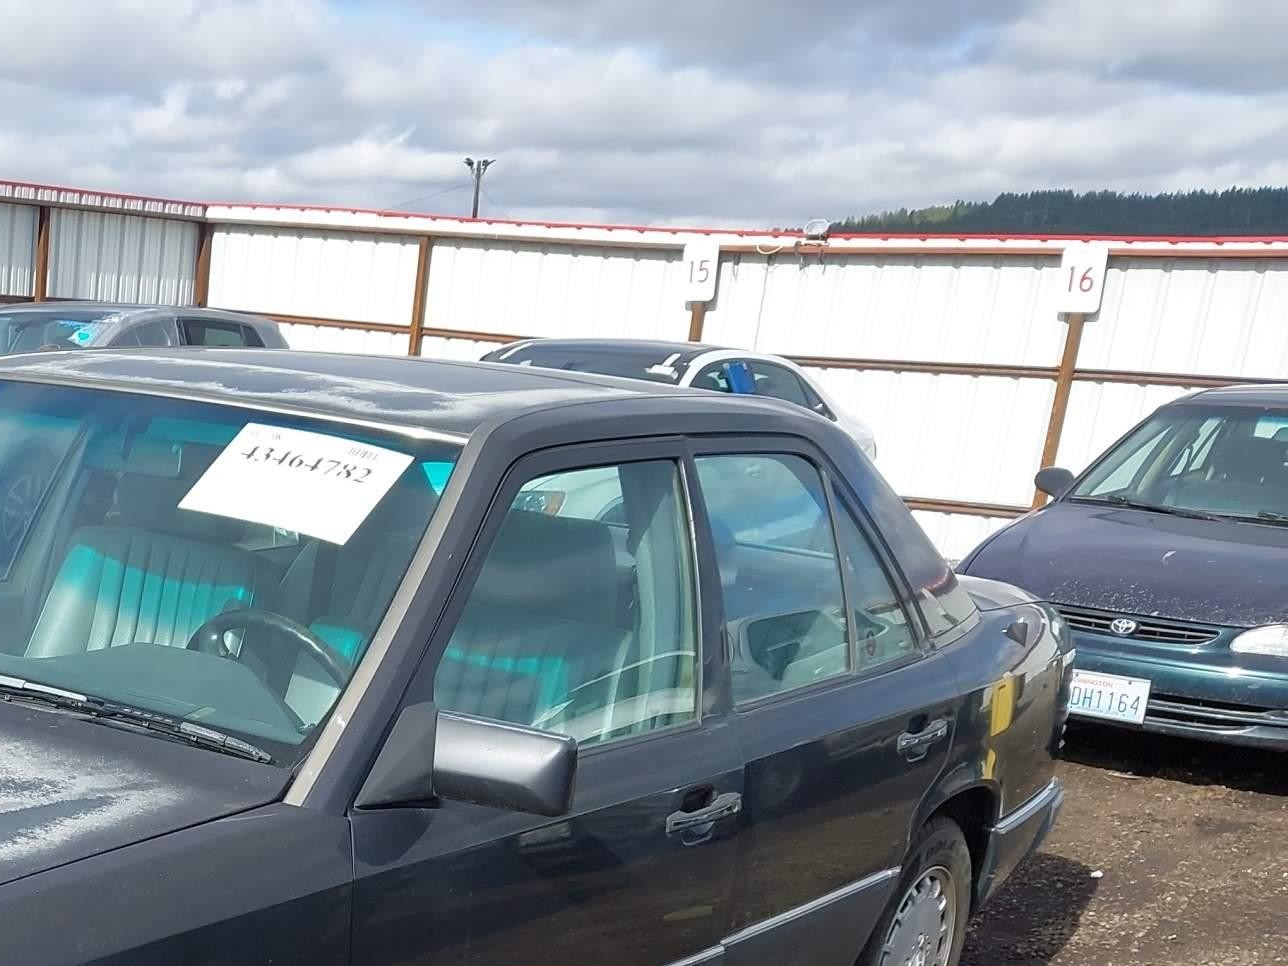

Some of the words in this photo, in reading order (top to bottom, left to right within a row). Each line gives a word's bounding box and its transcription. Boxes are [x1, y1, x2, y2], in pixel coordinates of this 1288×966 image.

[689, 260, 710, 284] 15
[1068, 266, 1094, 293] 16
[241, 446, 372, 483] 43464782
[1070, 686, 1141, 716] DH1164
